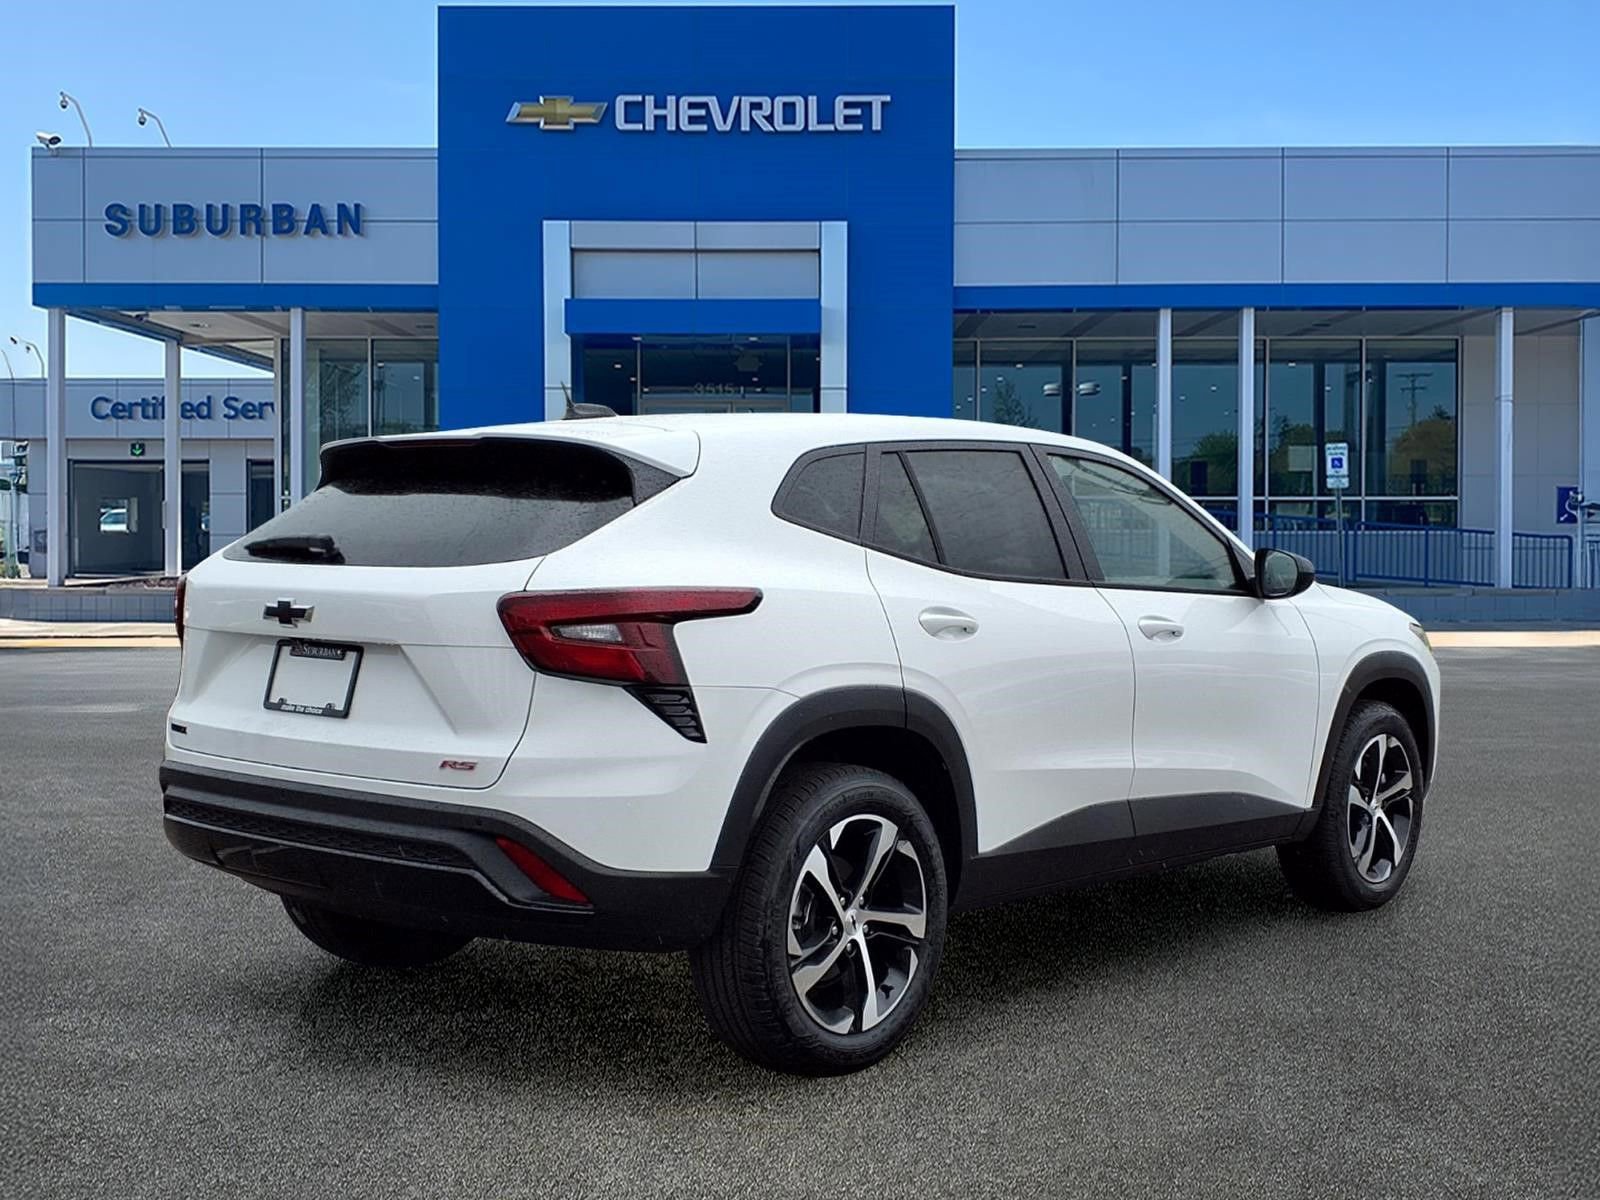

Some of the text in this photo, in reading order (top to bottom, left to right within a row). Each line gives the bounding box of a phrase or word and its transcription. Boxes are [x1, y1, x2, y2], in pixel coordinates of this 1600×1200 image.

[615, 95, 891, 131] CHEVROLET
[105, 202, 362, 236] SUBURBAN
[91, 395, 212, 420] Certifed
[439, 760, 478, 771] RS
